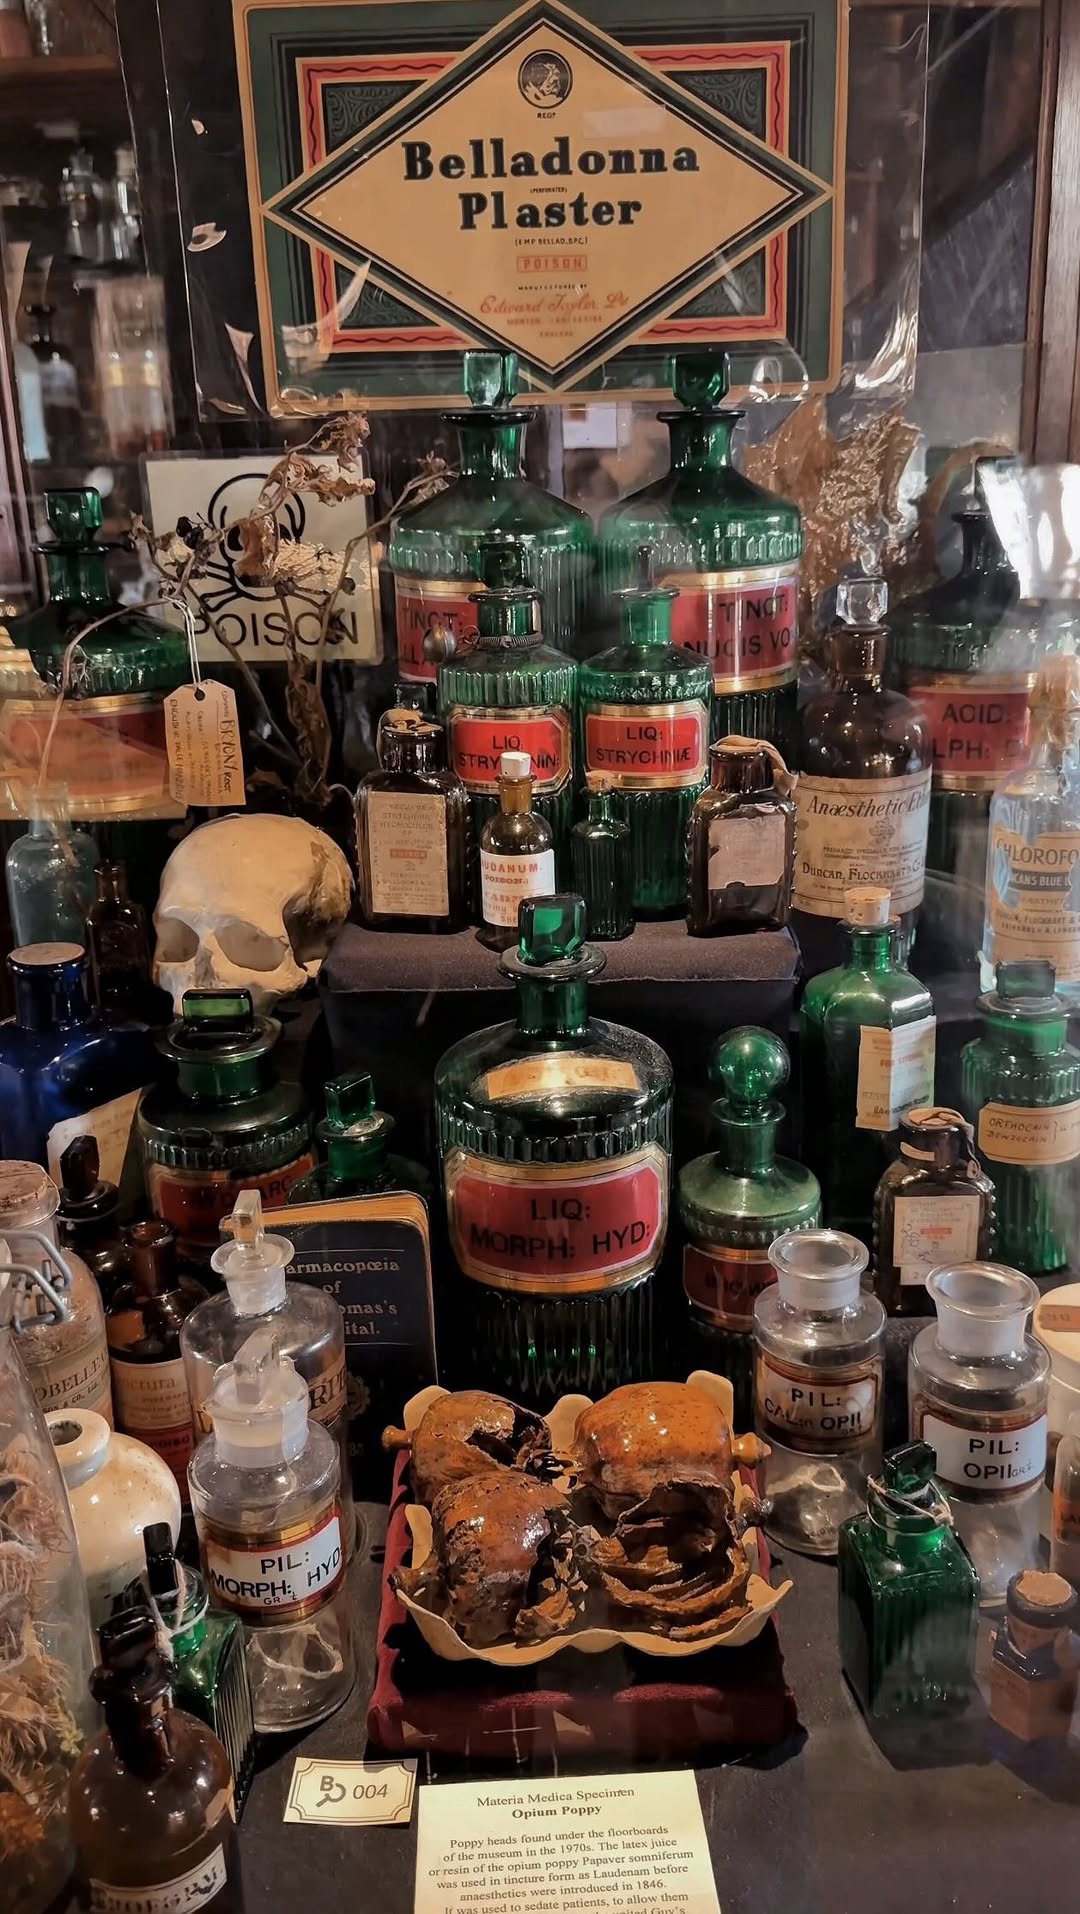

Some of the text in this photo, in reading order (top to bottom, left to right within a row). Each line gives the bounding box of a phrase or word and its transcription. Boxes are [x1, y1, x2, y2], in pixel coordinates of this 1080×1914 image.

[401, 136, 700, 181] Belladonna
[458, 191, 642, 230] Plaster
[523, 258, 582, 269] POISON
[625, 727, 664, 742] LIQ:
[1040, 875, 1064, 887] BLUE
[530, 1198, 592, 1221] LIQ:
[469, 1221, 651, 1260] MORPH: HYD:
[322, 1280, 342, 1294] of
[791, 1388, 841, 1407] PIL:
[969, 1438, 1020, 1456] PIL:
[963, 1462, 1012, 1480] OPII
[209, 1546, 341, 1599] MORPH: HYD
[260, 1551, 310, 1575] PIL:
[263, 1596, 281, 1605] GR
[352, 1783, 389, 1800] 004
[477, 1788, 635, 1807] Materia Medica Specimen
[512, 1805, 602, 1820] Opium Poppy
[450, 1825, 669, 1849] Poppy heads found under the floorboards
[443, 1838, 678, 1862] of the museum in the 1970s. The latex juice
[428, 1850, 694, 1877] or resin of the opium poppy Papaver somniferum
[436, 1864, 689, 1889] was used in tincture form as Laudenam before
[460, 1879, 667, 1901] anaesthetics were introduced in 1846.
[481, 1904, 507, 1914] used
[510, 1902, 522, 1912] to
[524, 1900, 560, 1911] sedate
[563, 1898, 610, 1911] patients,
[613, 1896, 624, 1906] to
[627, 1894, 658, 1905] allow
[661, 1892, 689, 1902] them
